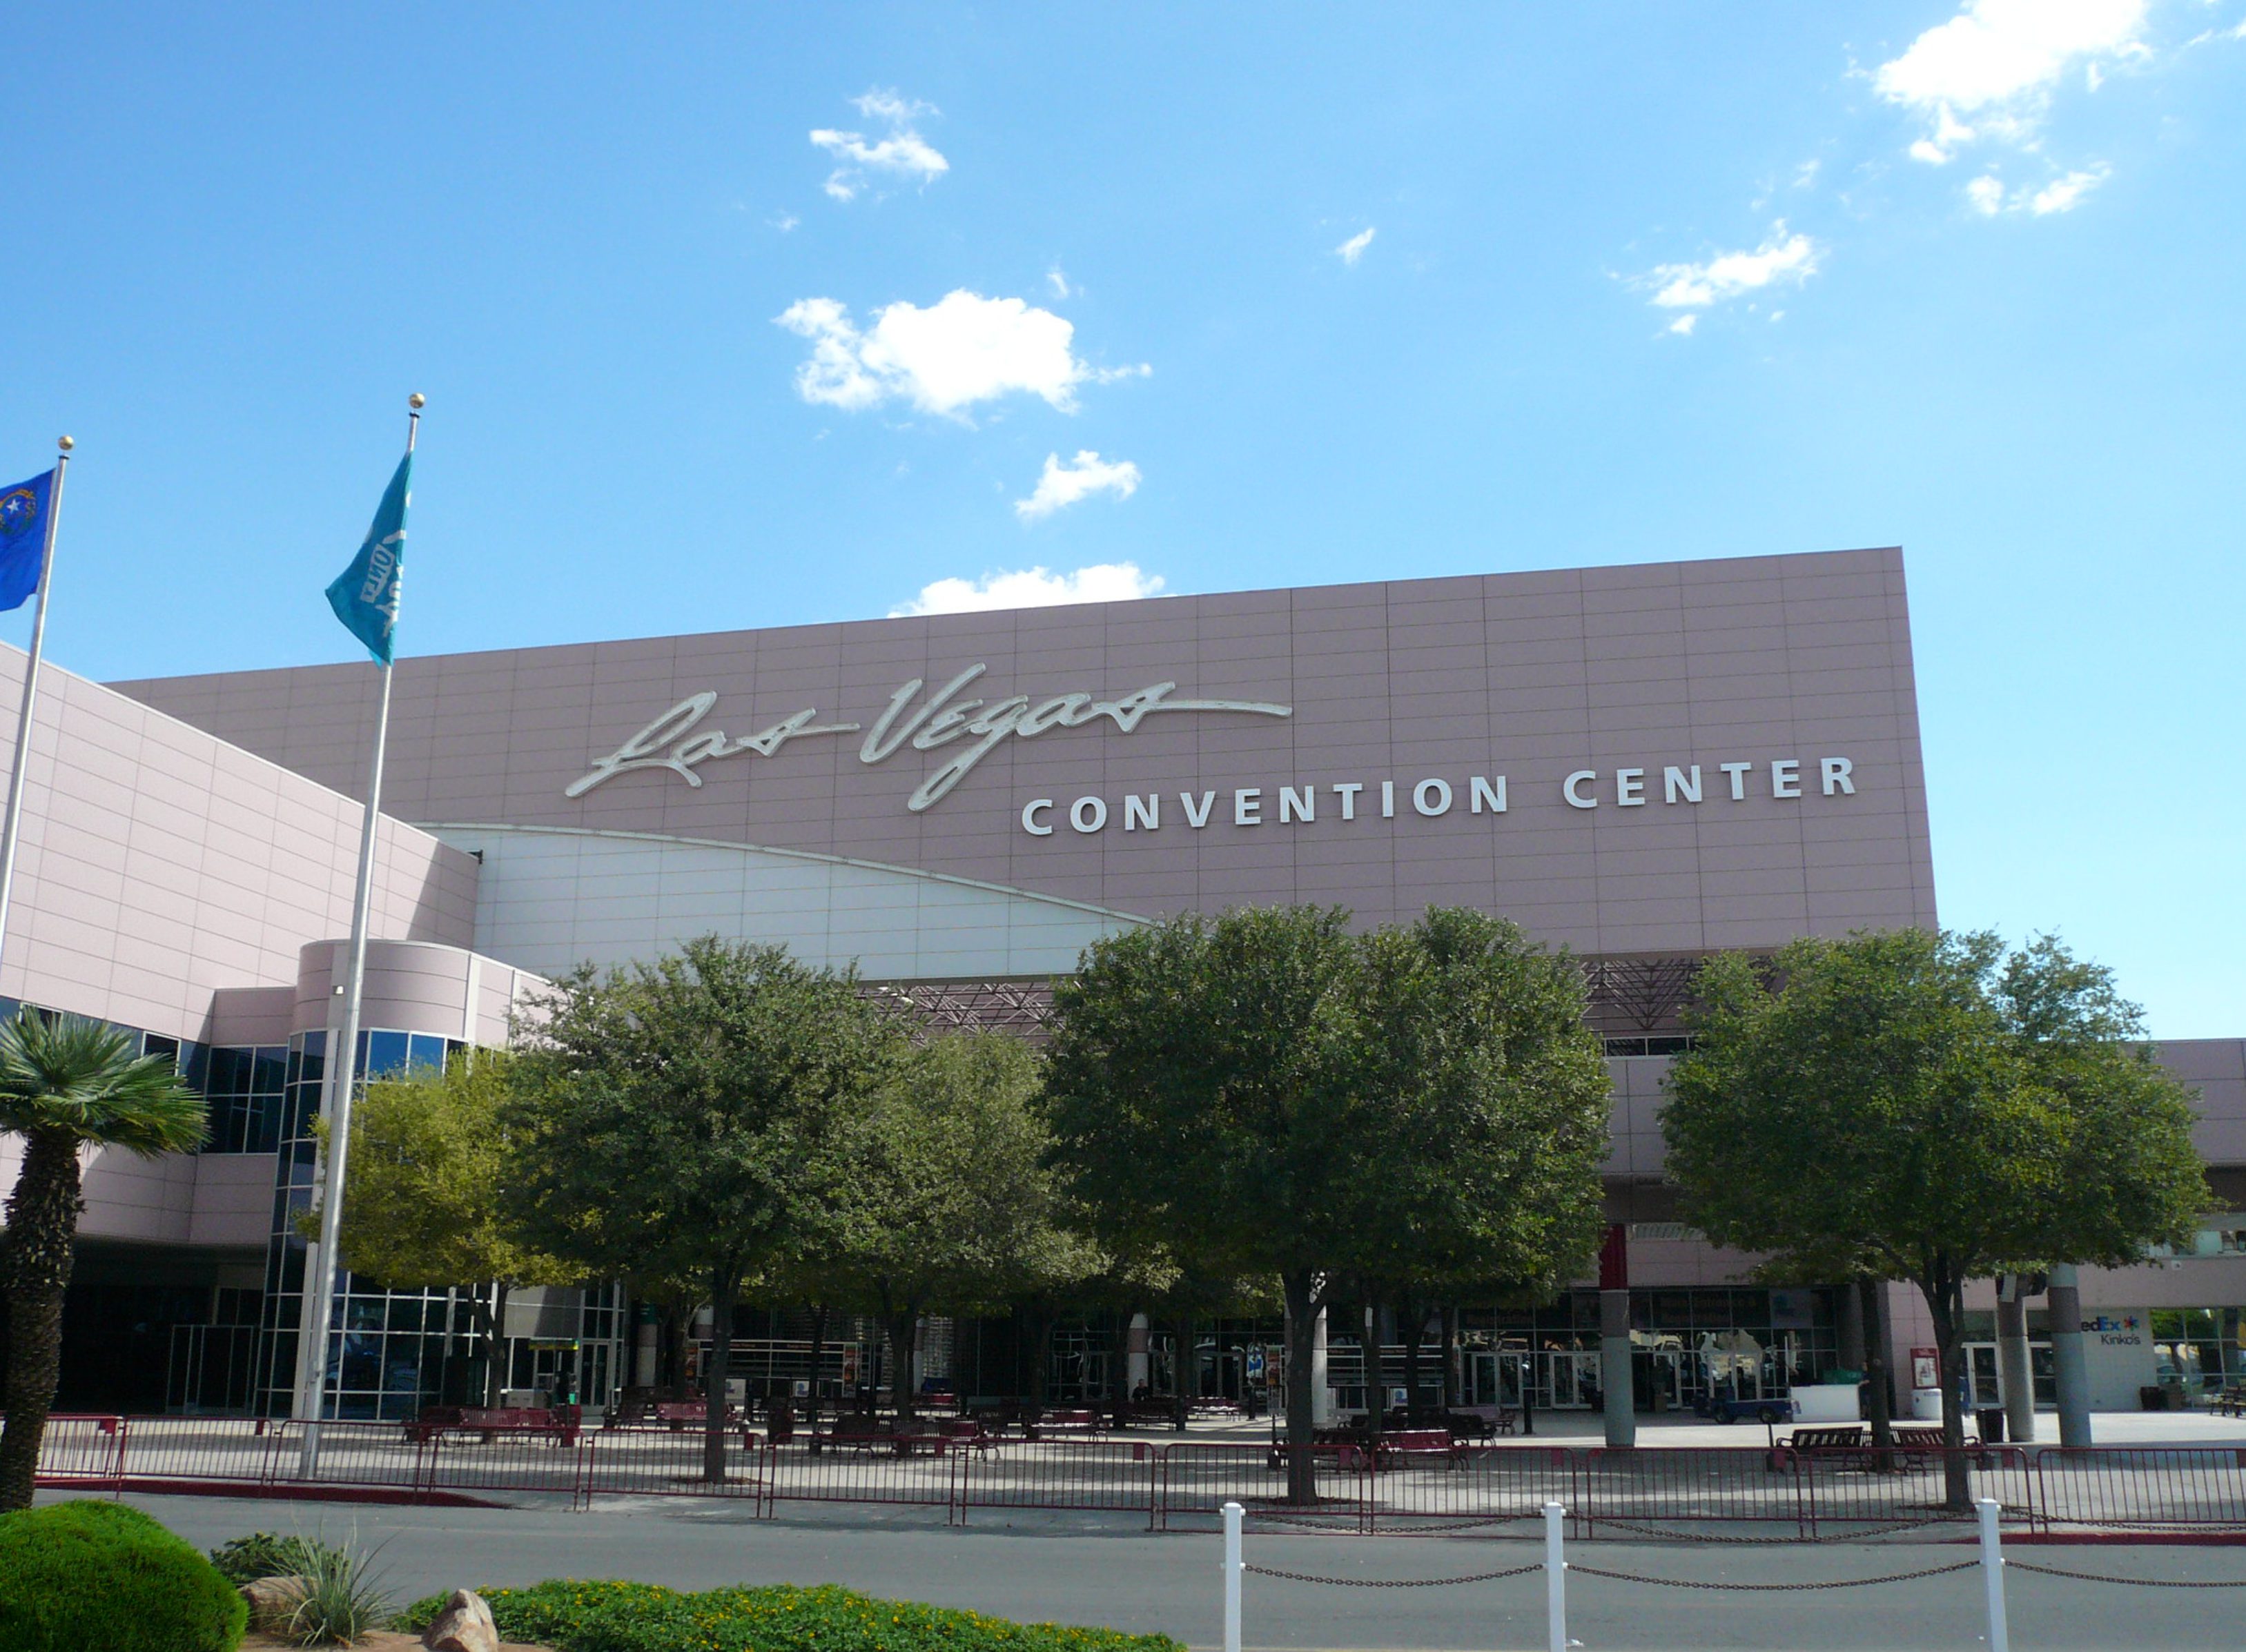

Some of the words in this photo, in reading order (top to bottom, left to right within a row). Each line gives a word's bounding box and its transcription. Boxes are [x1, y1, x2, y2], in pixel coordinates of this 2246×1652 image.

[565, 690, 861, 798] Las
[859, 662, 1293, 812] Vegas
[1021, 775, 1508, 835] CONVENTION
[1563, 756, 1856, 809] CENTER
[2080, 1316, 2120, 1332] edEx
[2100, 1335, 2141, 1345] Kinko's
